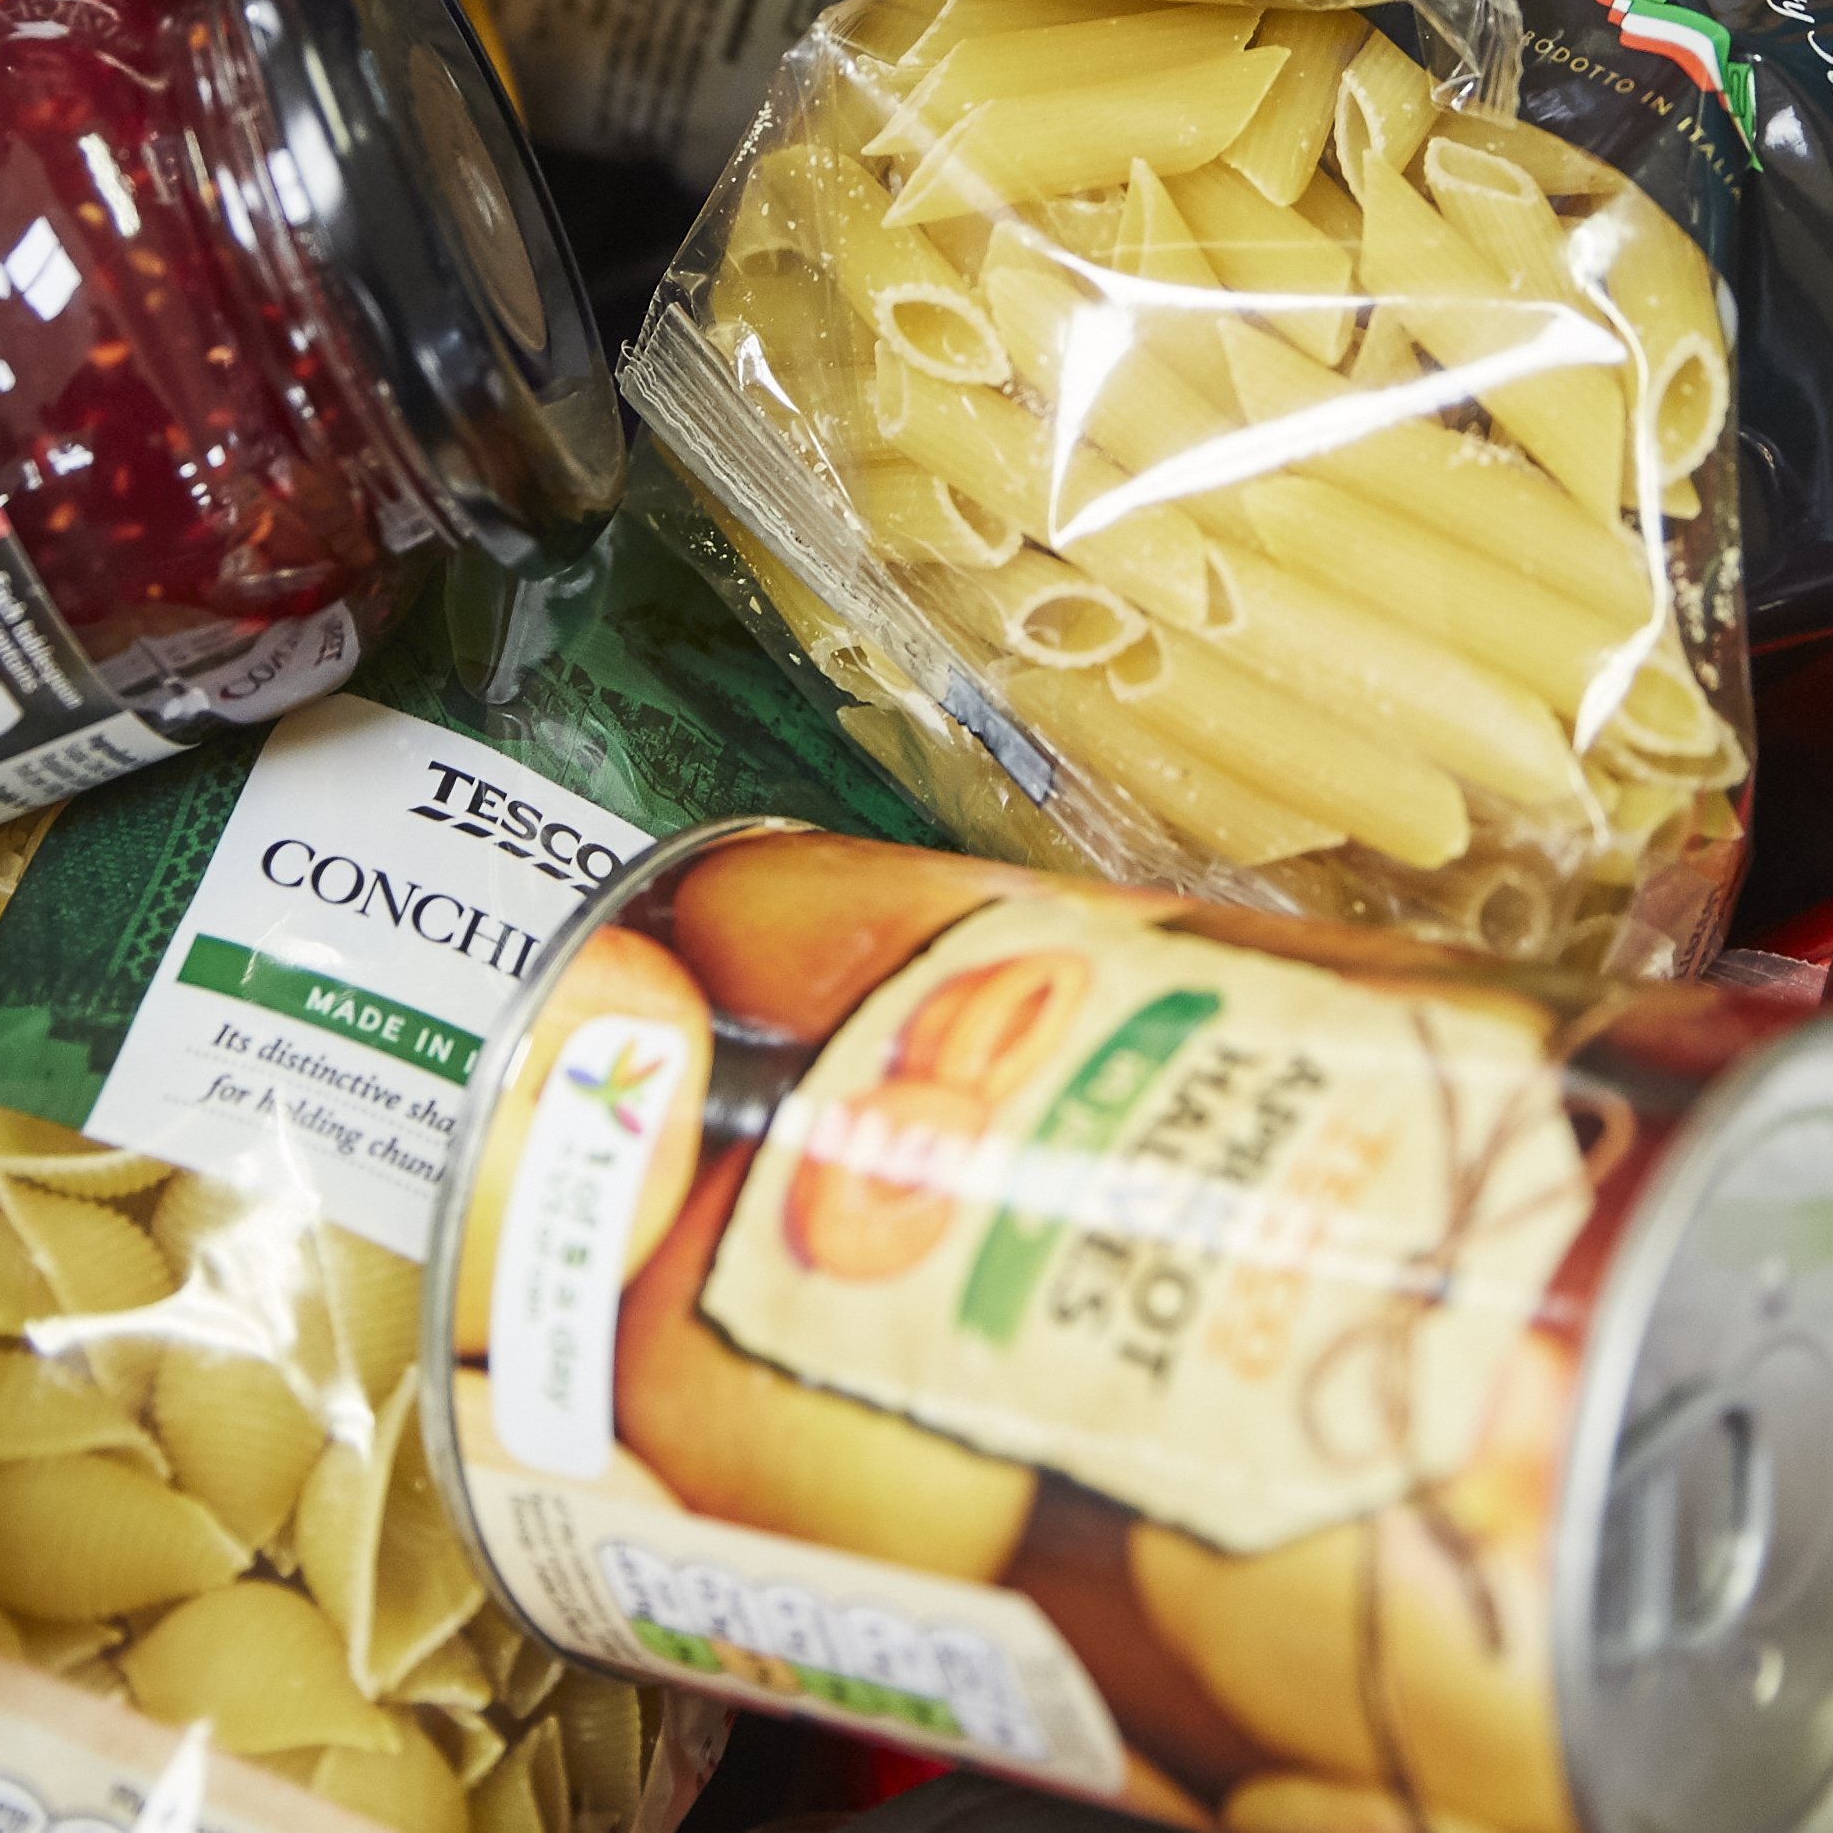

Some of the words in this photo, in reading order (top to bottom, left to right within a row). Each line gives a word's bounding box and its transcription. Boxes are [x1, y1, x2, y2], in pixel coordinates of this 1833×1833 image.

[1521, 26, 1636, 96] RODOTTO
[1640, 89, 1675, 118] IN
[425, 757, 623, 881] TESCO
[259, 837, 543, 981] CONCHI
[212, 1023, 252, 1054] Its
[257, 1037, 402, 1111] distinctive
[404, 1098, 459, 1141] sha
[304, 985, 408, 1043] MADE
[412, 1027, 456, 1065] IN
[197, 1072, 252, 1105] for
[257, 1086, 364, 1156] hlding
[367, 1135, 445, 1187] chun
